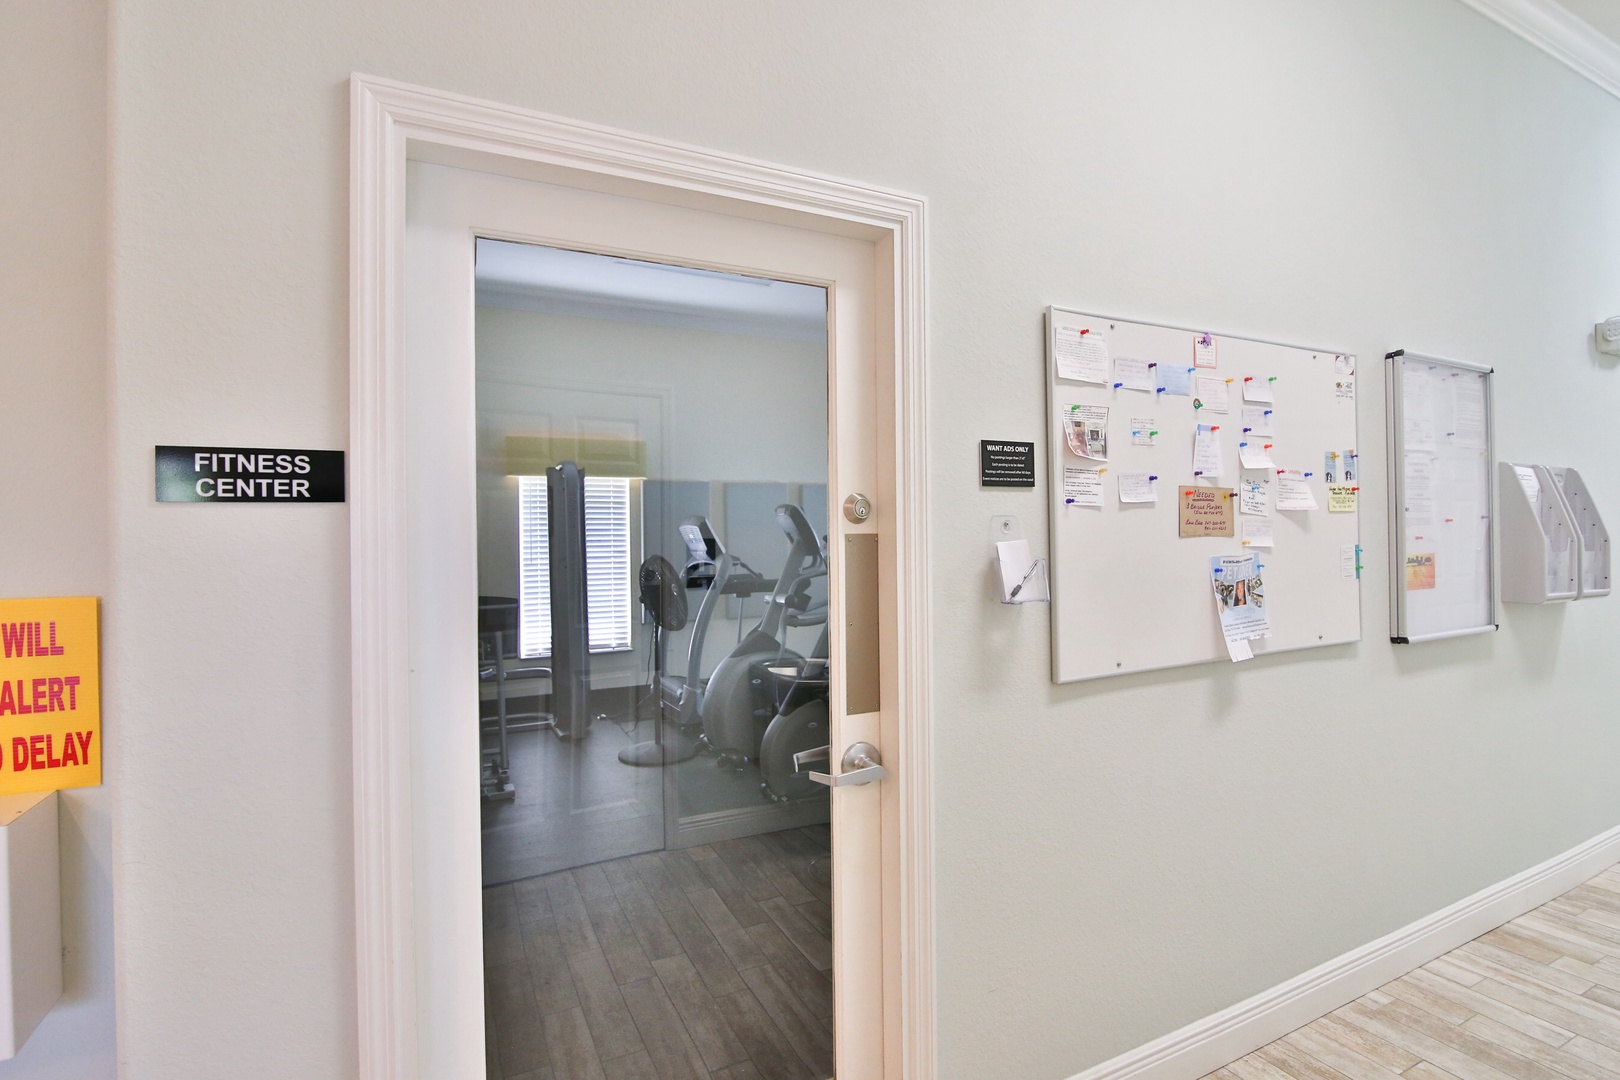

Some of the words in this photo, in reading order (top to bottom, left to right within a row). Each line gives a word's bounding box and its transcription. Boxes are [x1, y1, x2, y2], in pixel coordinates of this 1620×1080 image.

[194, 453, 311, 474] FITNESS
[195, 478, 311, 498] CENTER
[1, 620, 64, 658] WILL
[0, 676, 80, 716] ALERT
[12, 730, 93, 772] DELAY
